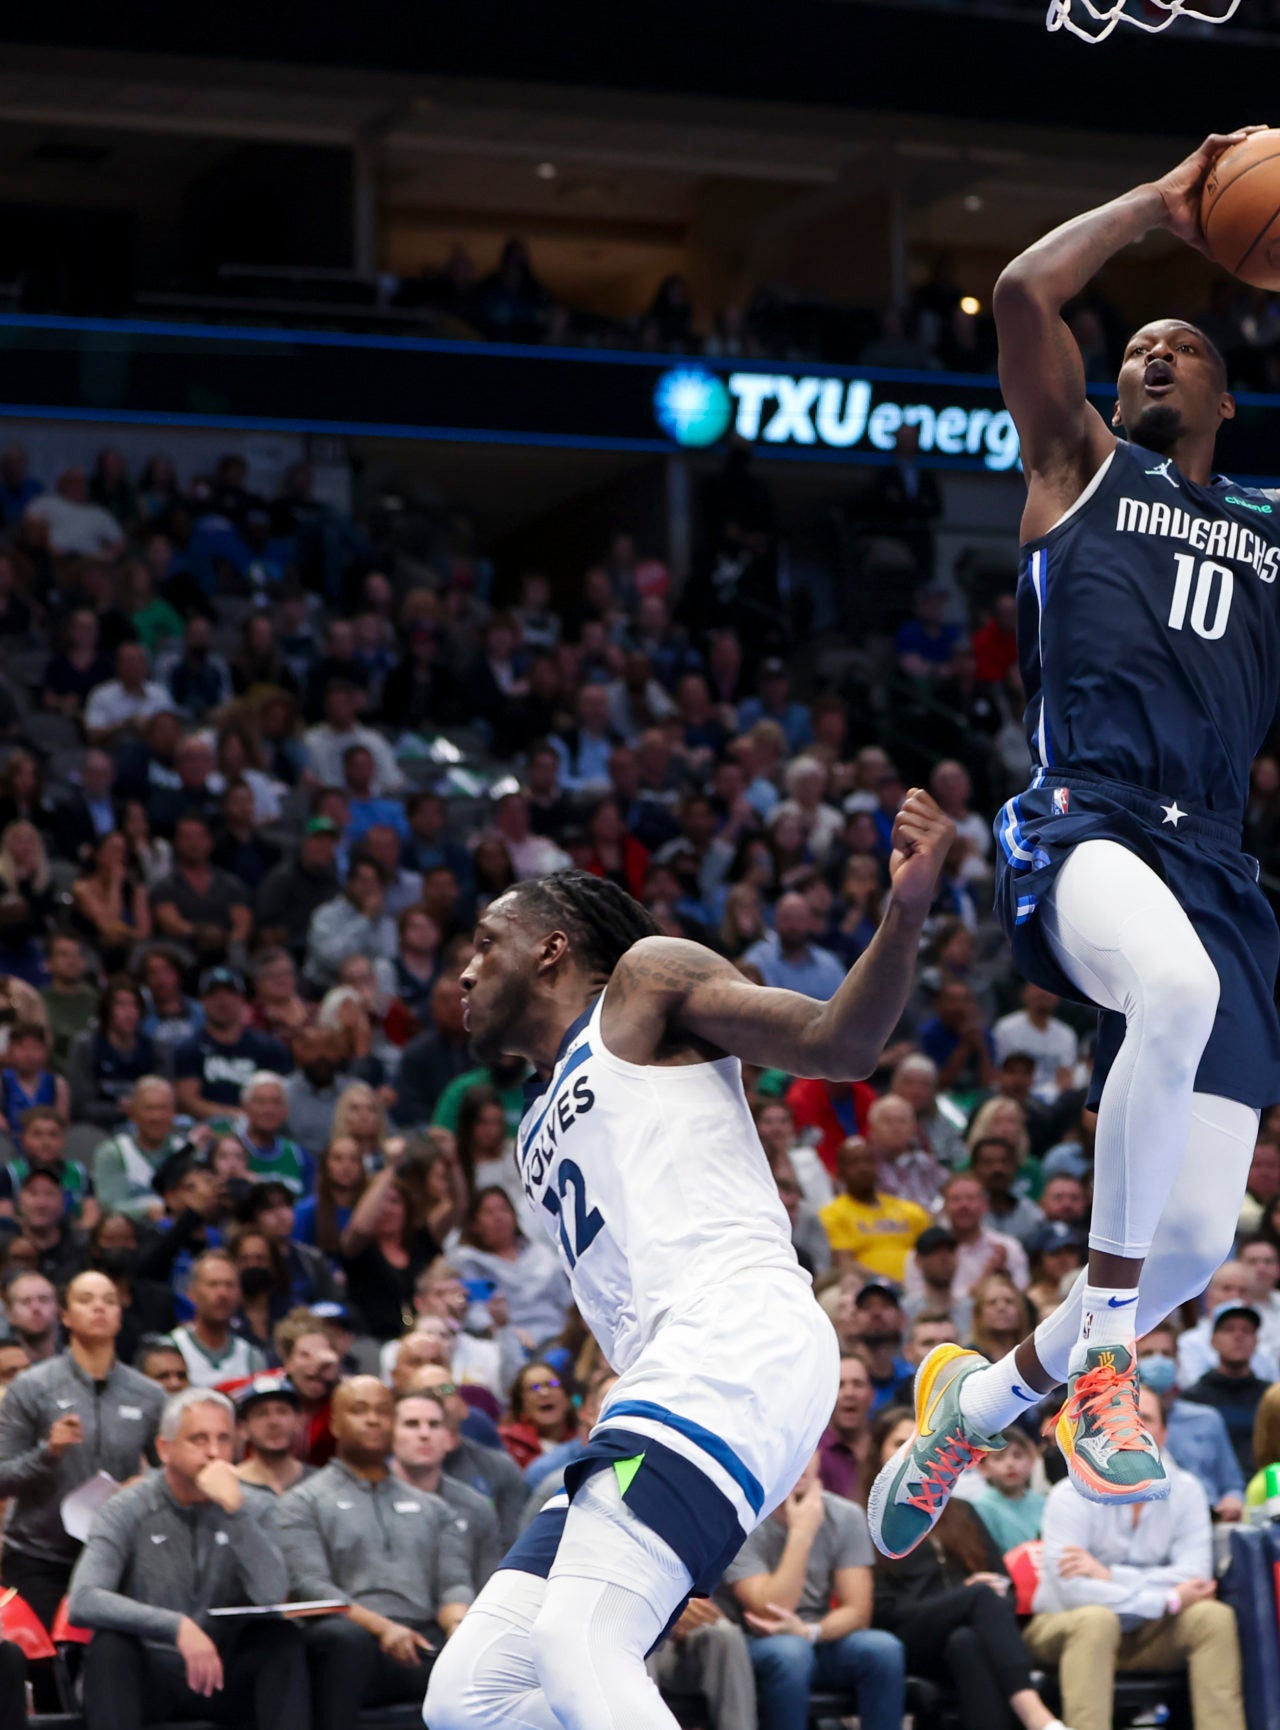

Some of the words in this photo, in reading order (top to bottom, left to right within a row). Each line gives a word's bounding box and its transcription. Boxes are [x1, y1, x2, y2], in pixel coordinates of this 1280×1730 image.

[729, 372, 873, 449] TXU
[867, 401, 1023, 472] energ
[1168, 552, 1234, 640] 10
